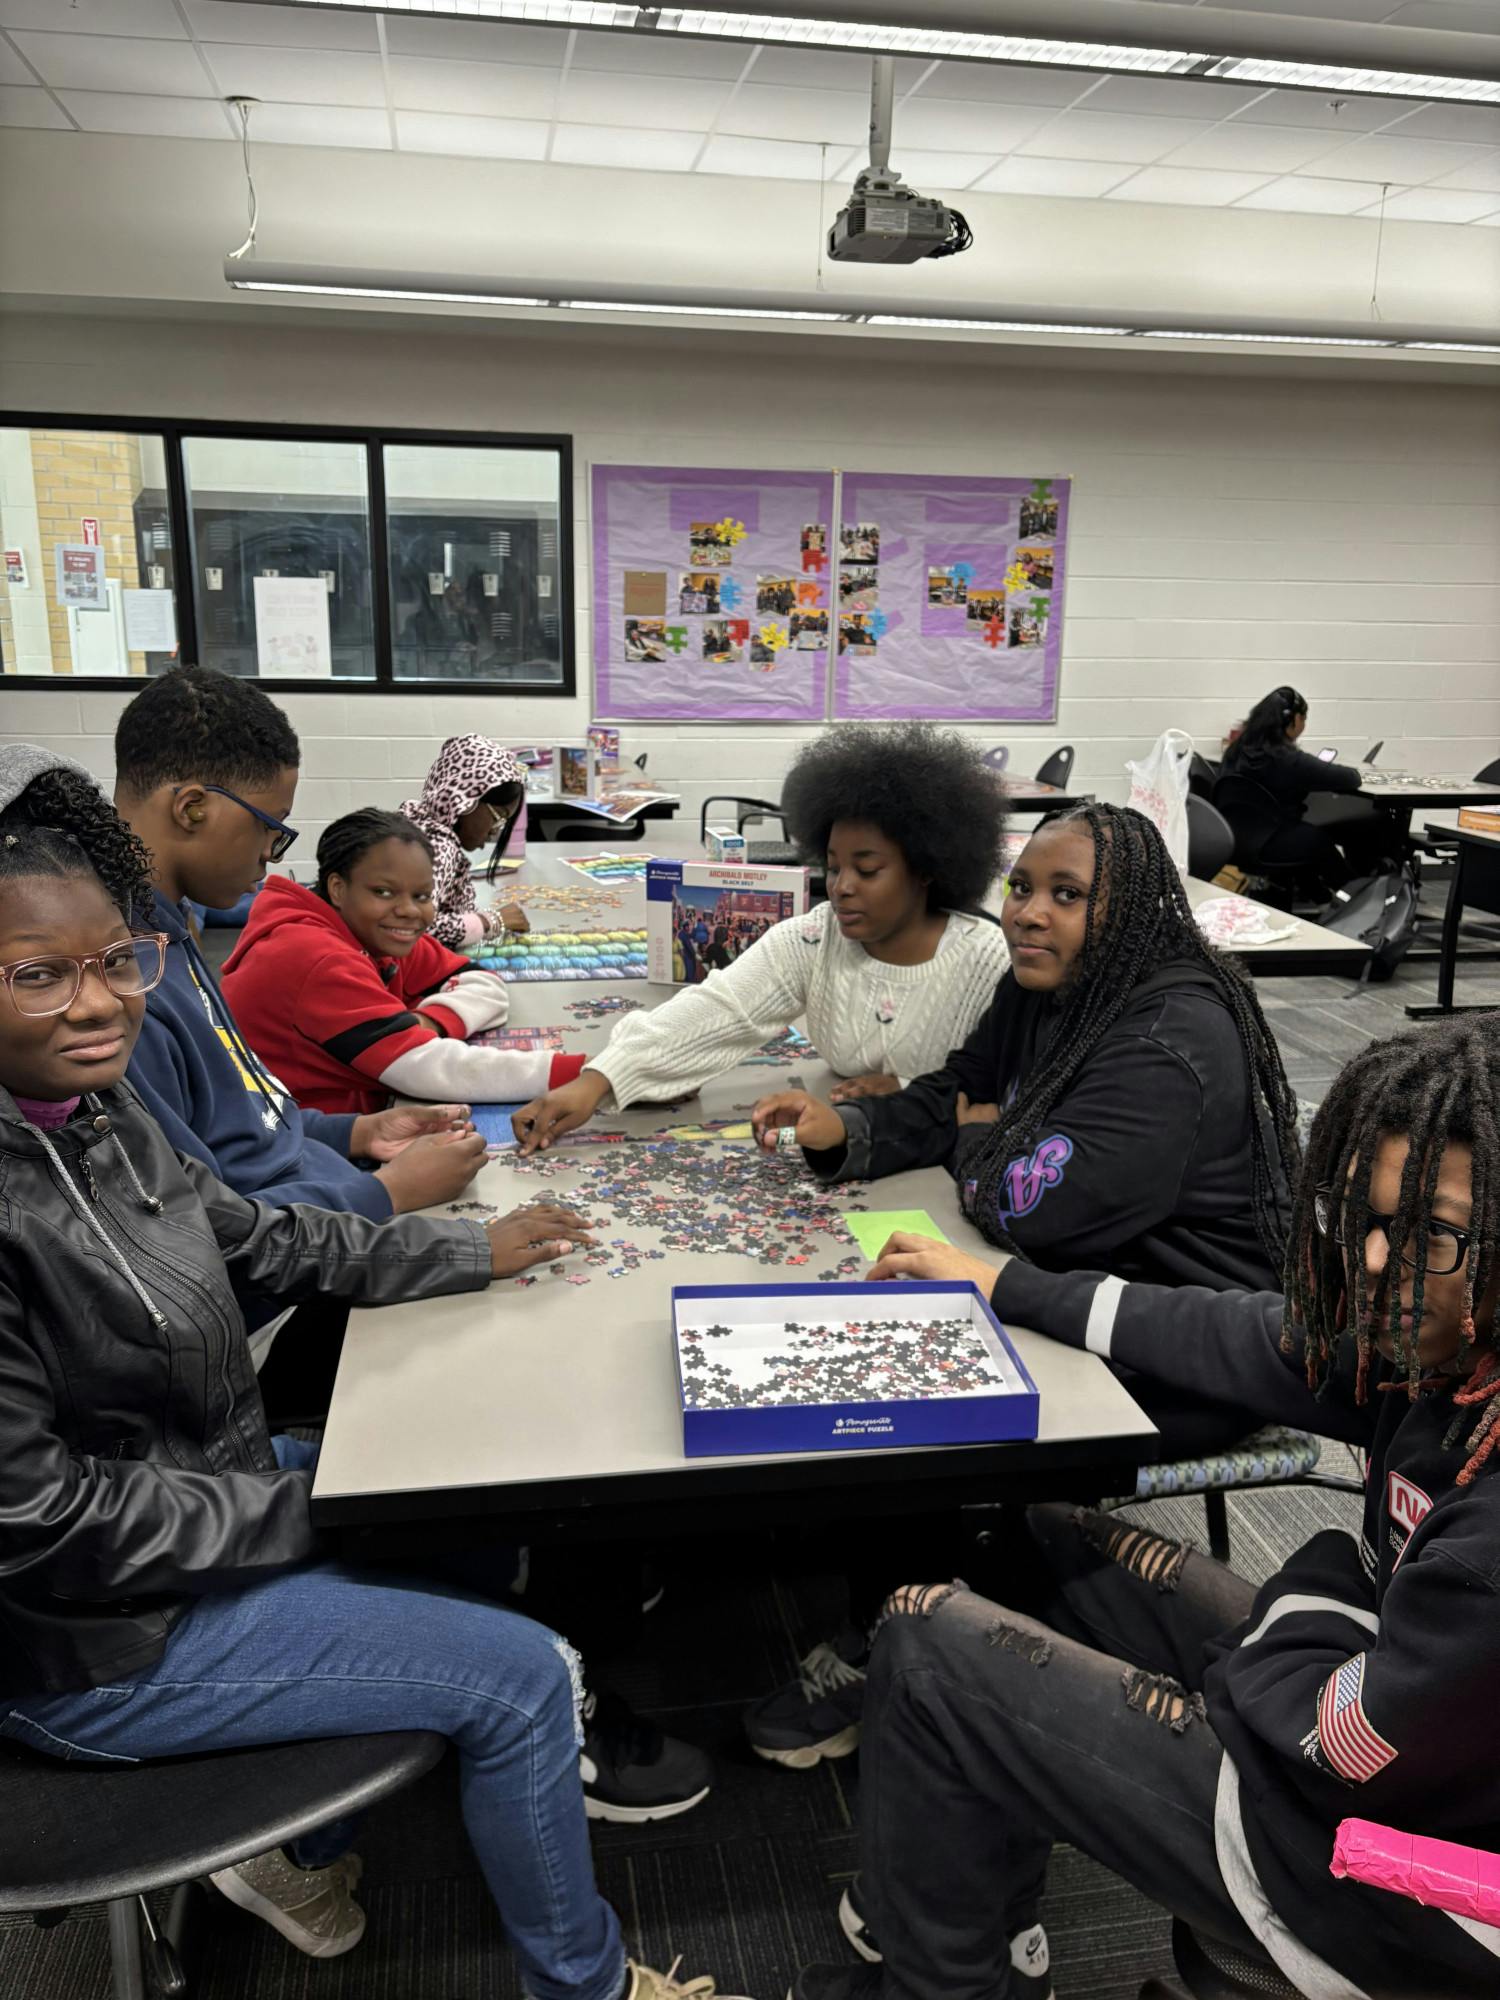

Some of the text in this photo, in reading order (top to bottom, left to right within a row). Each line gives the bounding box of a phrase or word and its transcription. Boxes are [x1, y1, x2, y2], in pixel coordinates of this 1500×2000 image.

[709, 870, 768, 881] ARCHIBALD MOTLEY
[867, 1425, 894, 1433] PUZZLE
